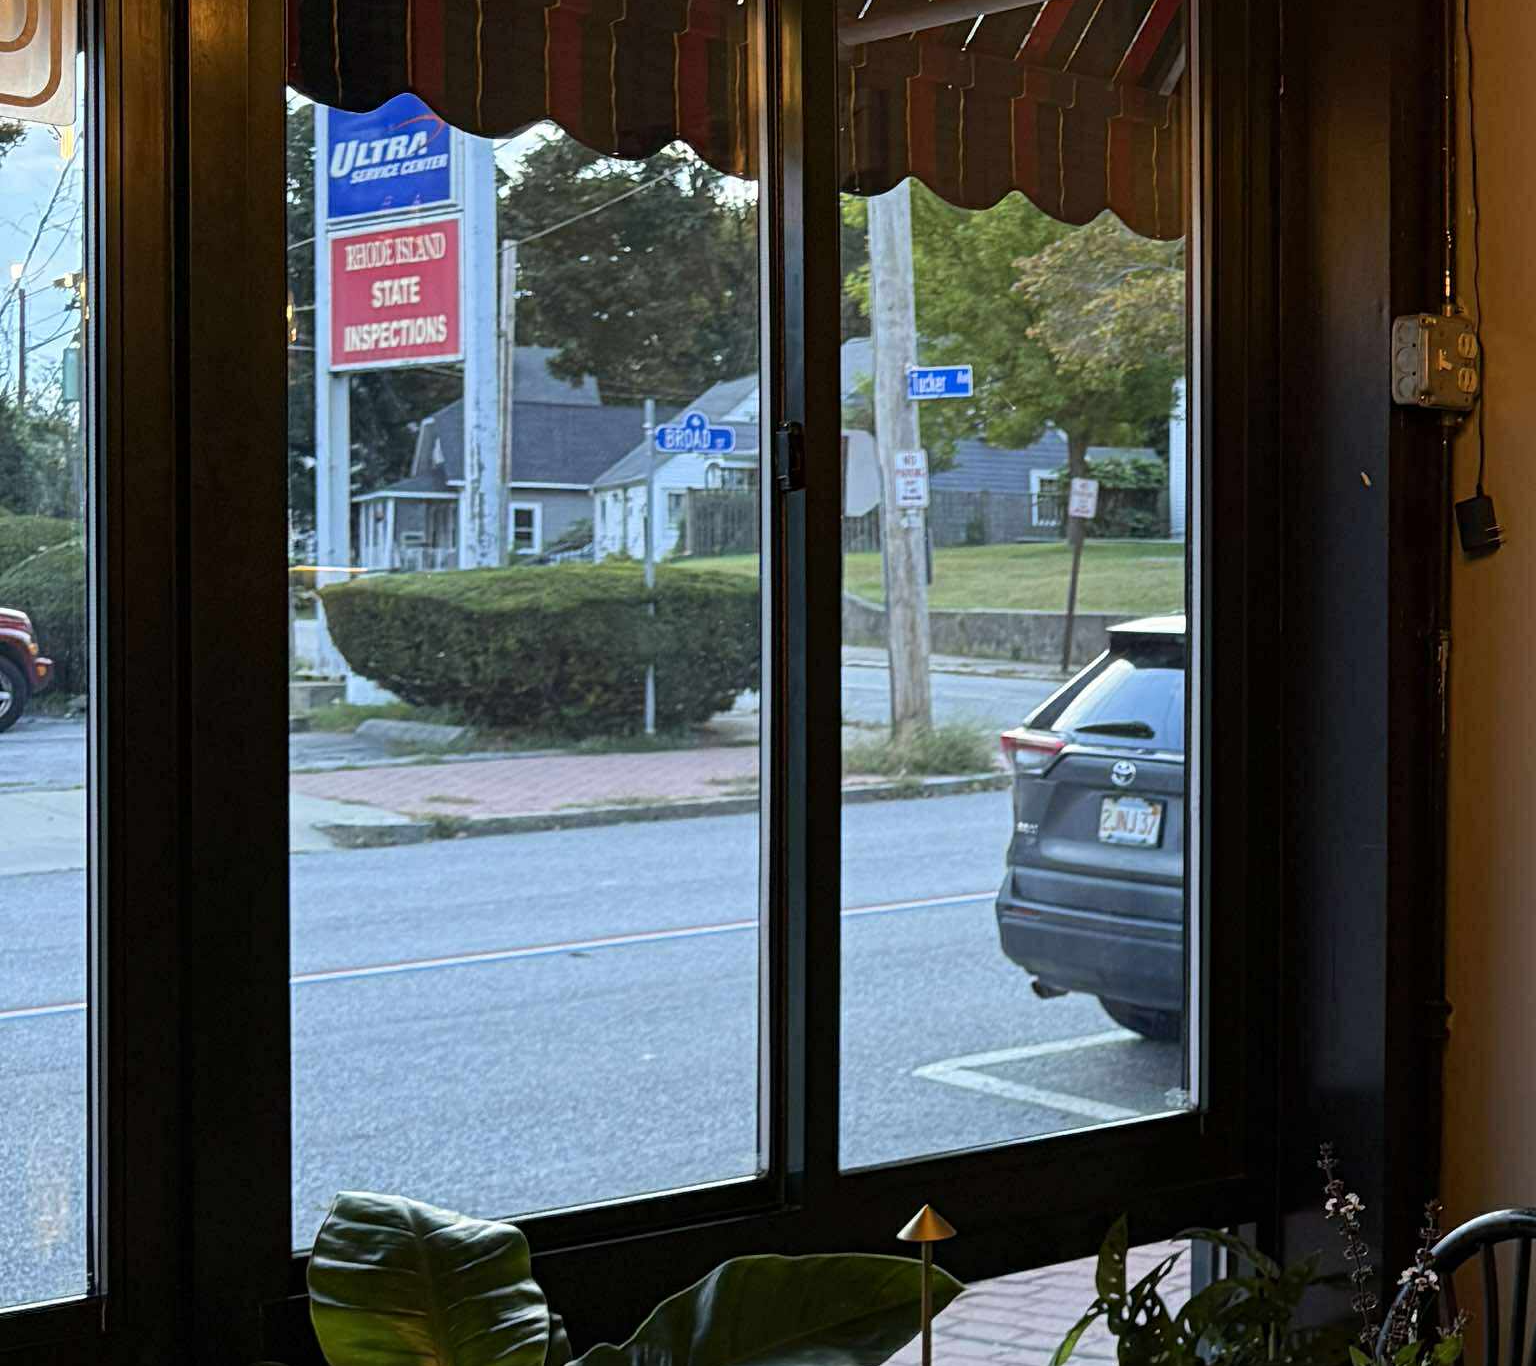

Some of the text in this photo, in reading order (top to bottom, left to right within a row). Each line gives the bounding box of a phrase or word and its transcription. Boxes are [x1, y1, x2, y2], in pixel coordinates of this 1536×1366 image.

[330, 131, 428, 177] ULTRA
[350, 154, 449, 184] SERVICE CENTER
[344, 232, 446, 271] RHODE ISLAND
[371, 276, 421, 308] STATE
[343, 314, 448, 352] INSPECTIONS
[664, 428, 711, 450] BROAD
